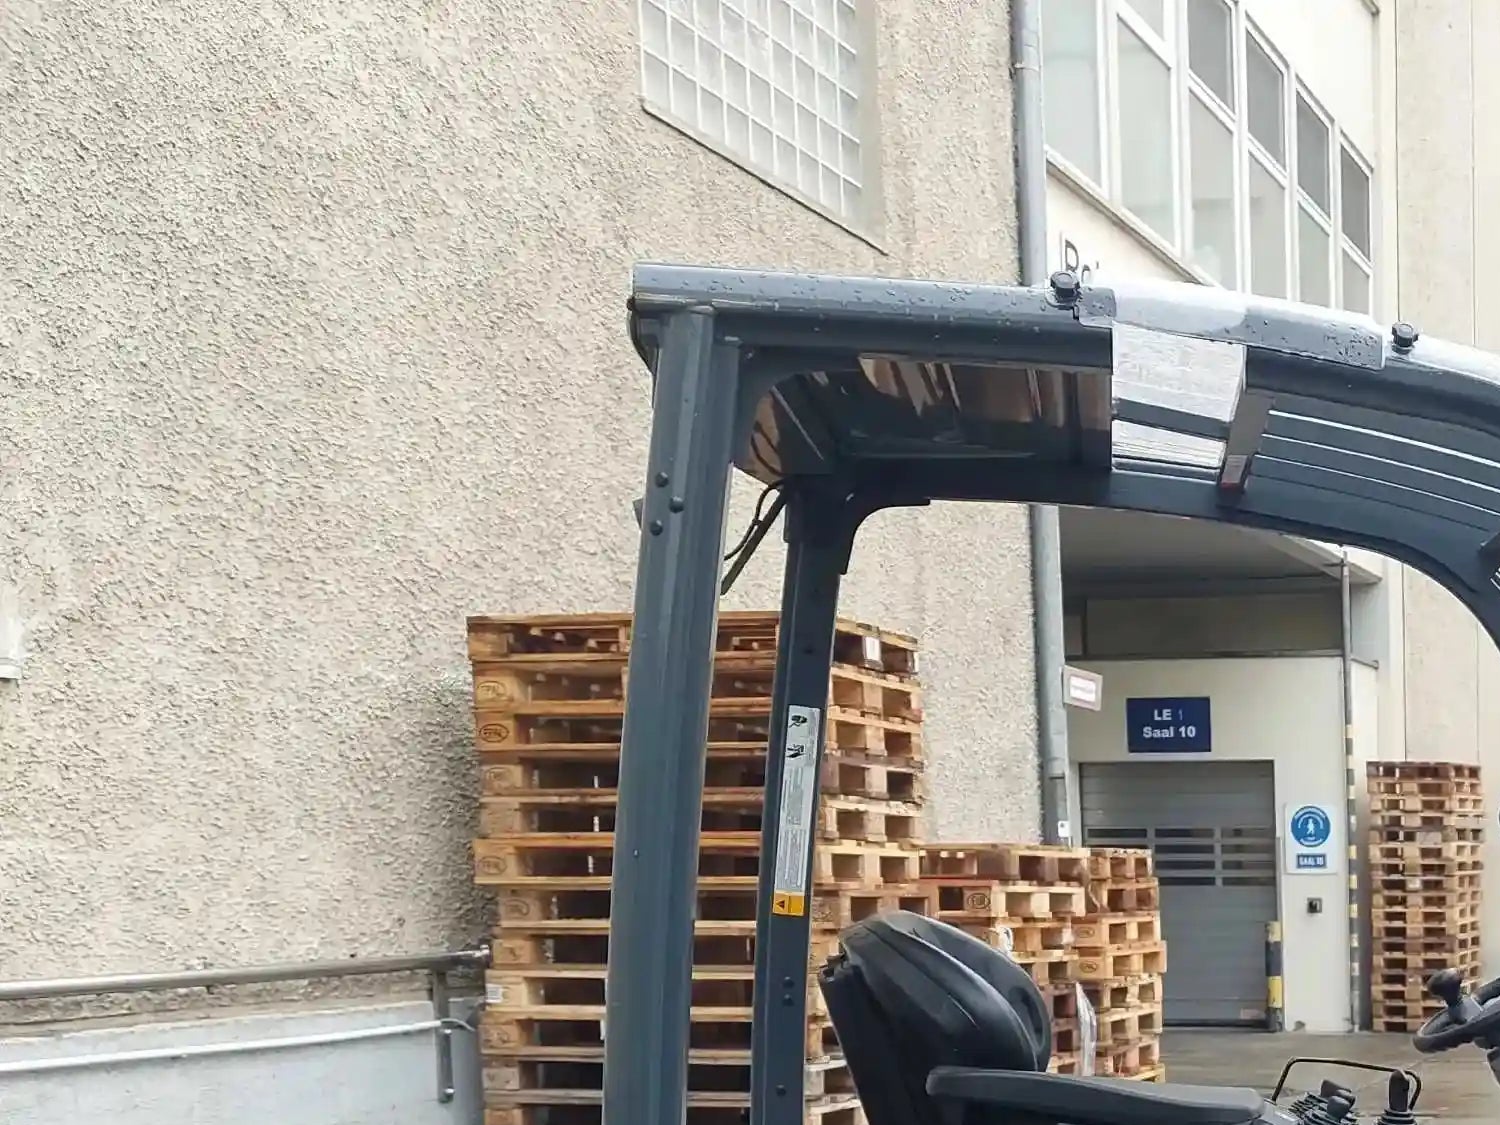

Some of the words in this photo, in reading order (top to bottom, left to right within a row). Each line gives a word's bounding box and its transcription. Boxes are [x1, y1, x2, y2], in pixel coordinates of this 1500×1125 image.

[1153, 708, 1172, 721] LE
[1143, 726, 1174, 738] Saal
[1178, 726, 1196, 738] 10
